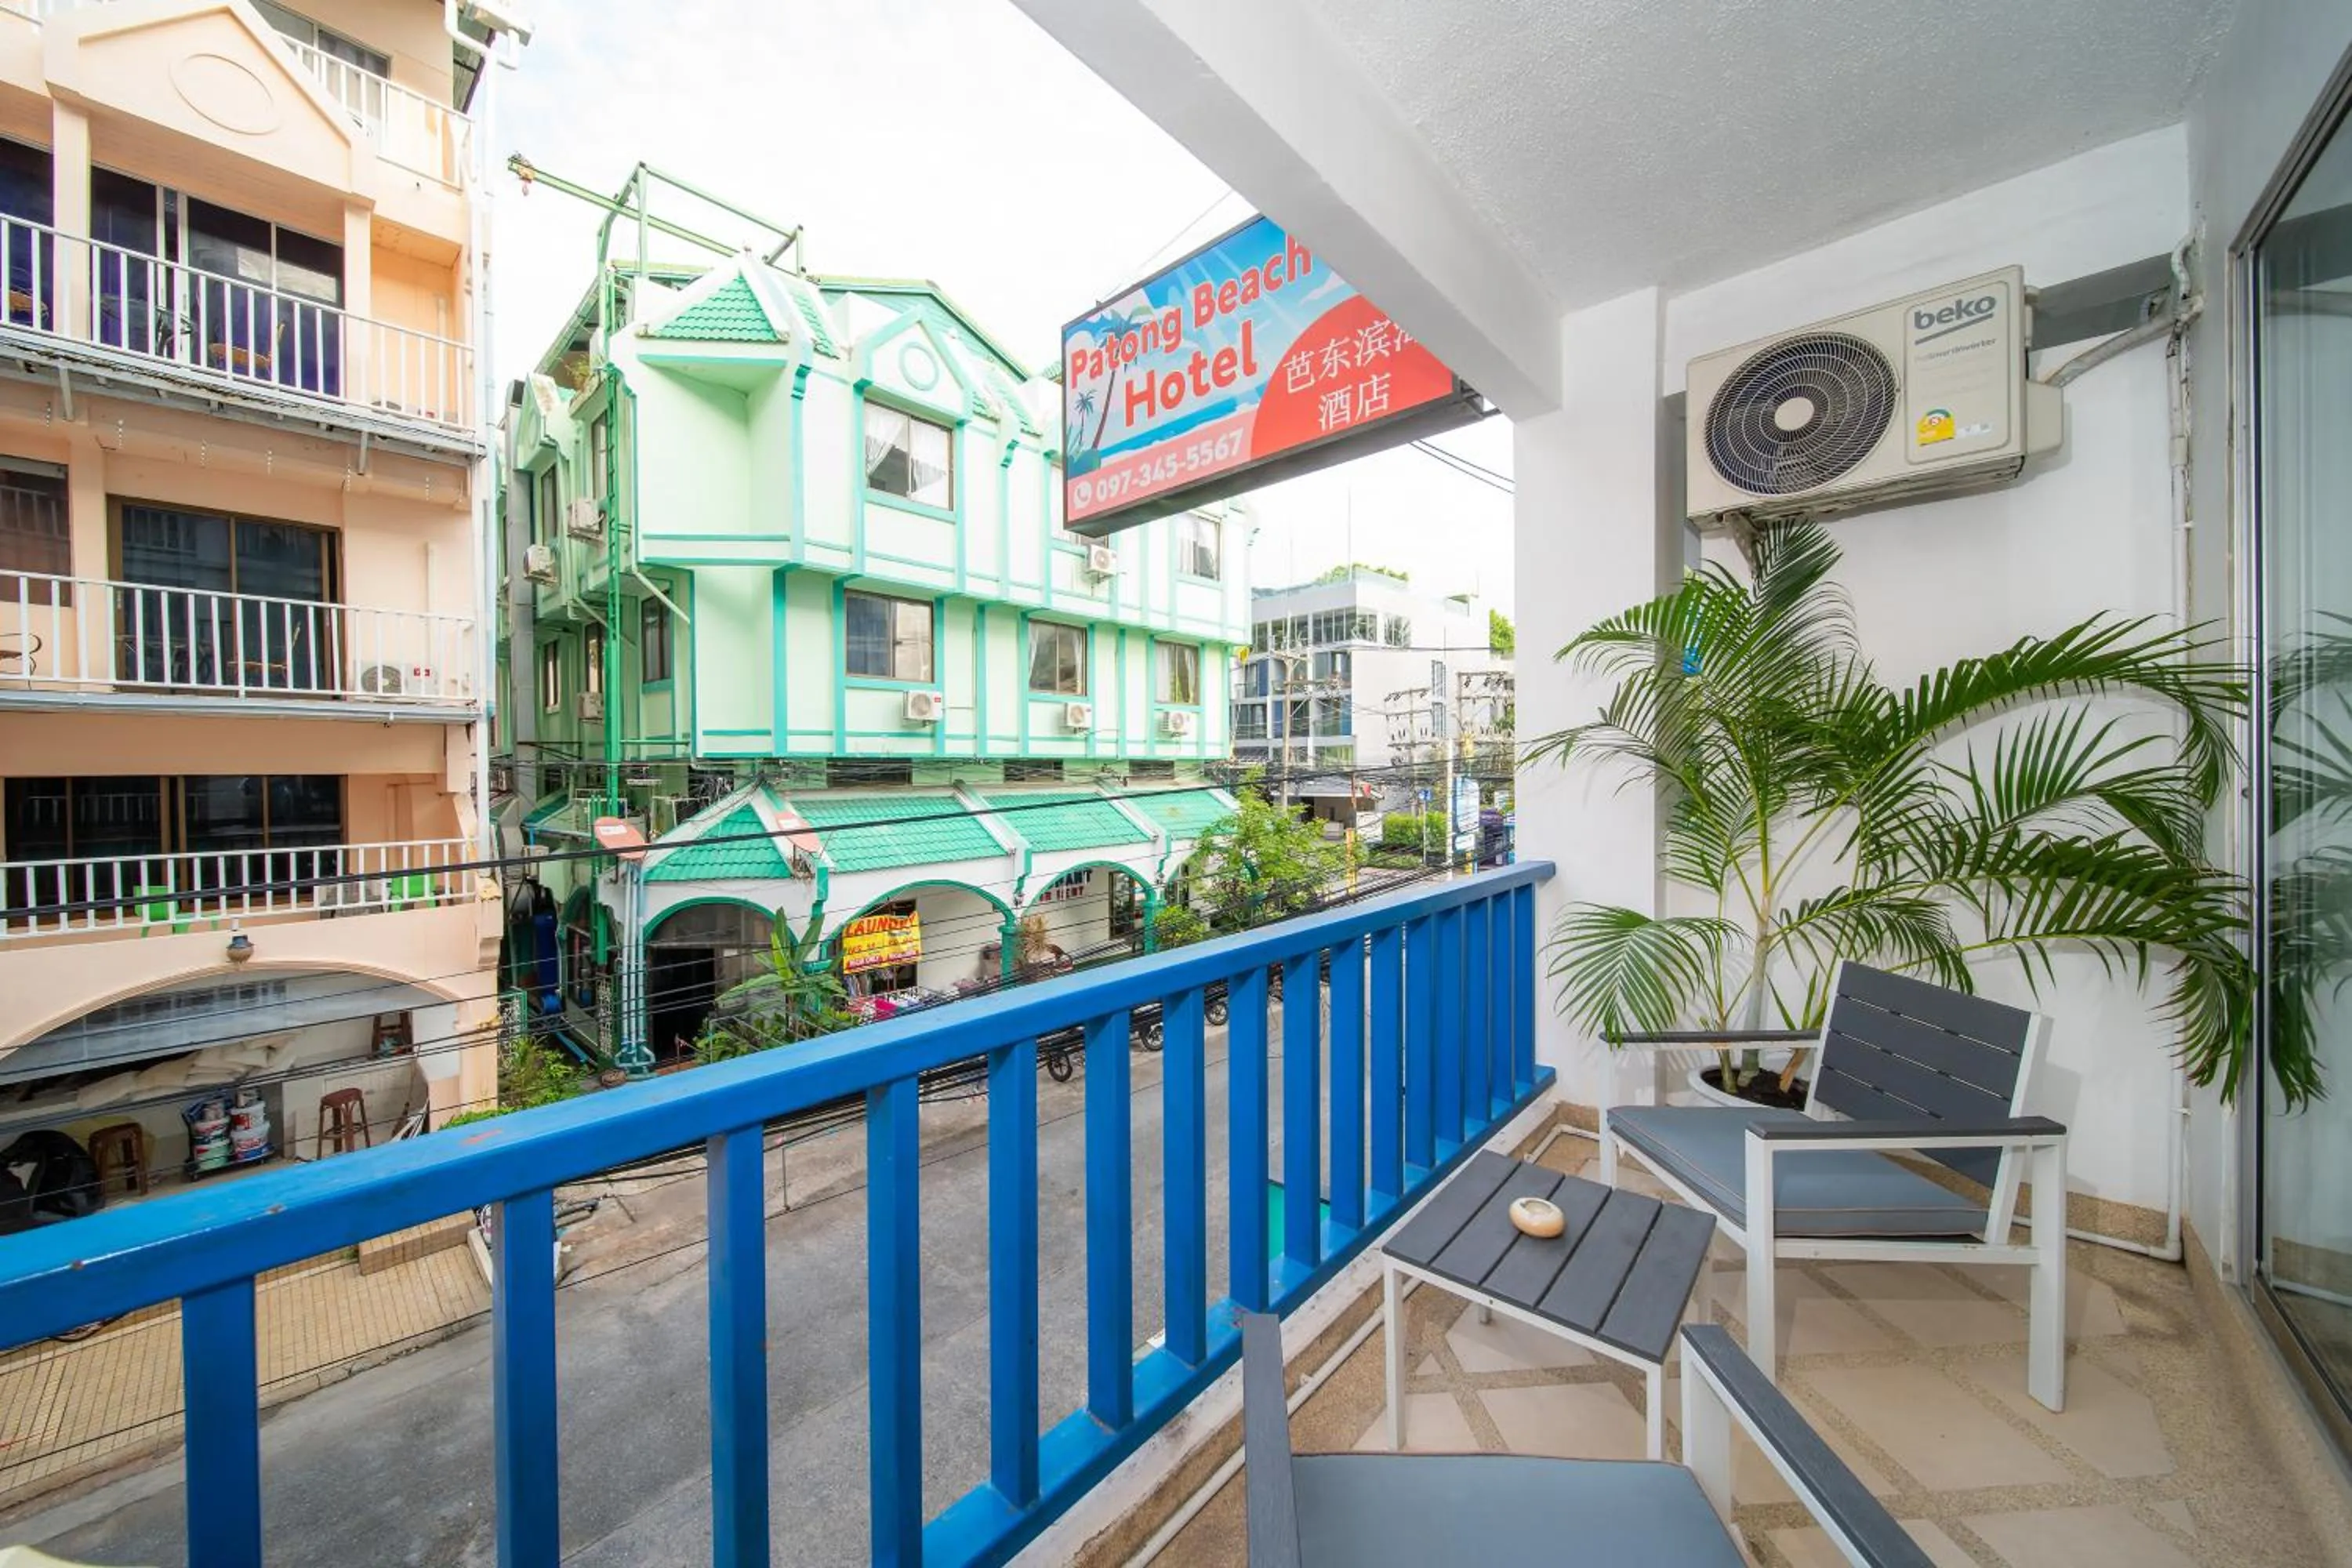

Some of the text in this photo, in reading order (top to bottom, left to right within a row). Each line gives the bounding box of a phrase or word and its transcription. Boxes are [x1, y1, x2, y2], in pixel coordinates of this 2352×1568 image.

[1070, 234, 1312, 390] Patong Beach
[1914, 296, 1996, 329] beko
[1123, 319, 1257, 428] Hotel
[1318, 372, 1392, 430] 酒店
[1096, 426, 1243, 503] 097-345-5567
